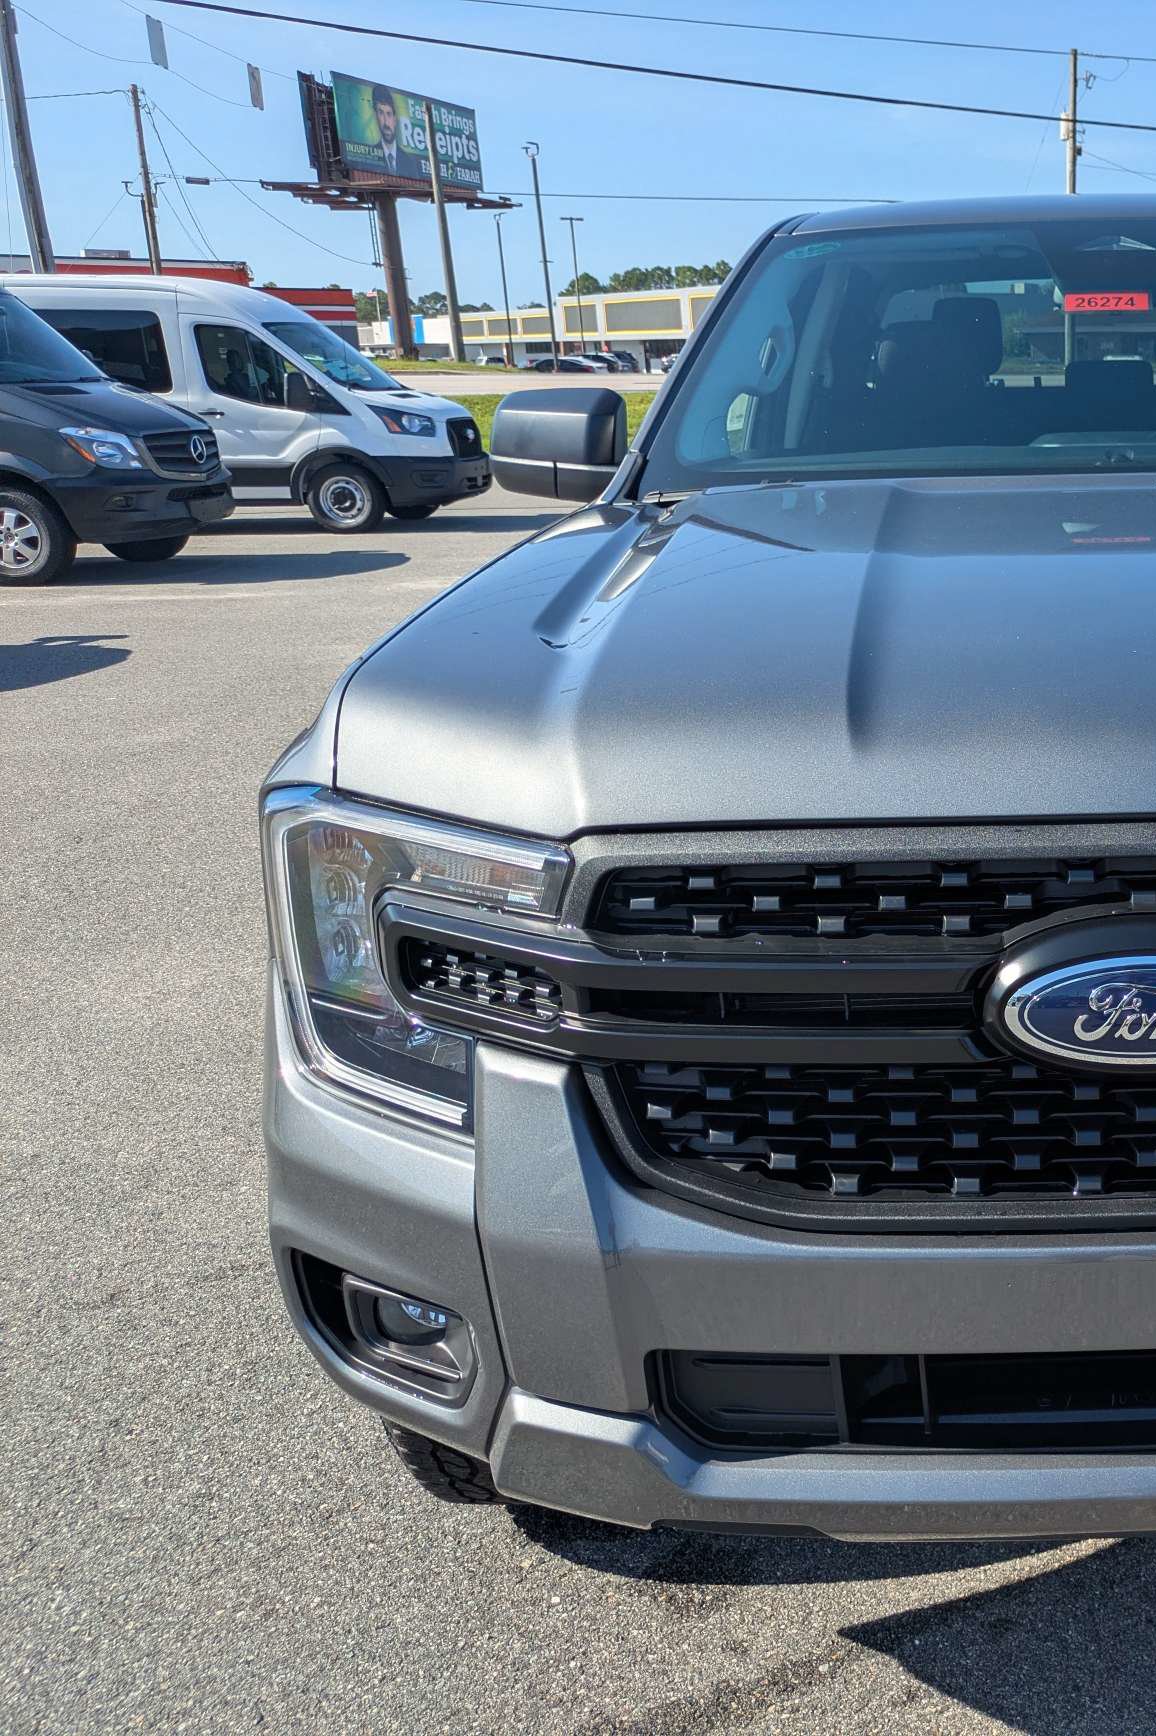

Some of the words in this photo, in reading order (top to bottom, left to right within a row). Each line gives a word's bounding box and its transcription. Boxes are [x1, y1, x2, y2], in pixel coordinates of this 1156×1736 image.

[441, 107, 474, 135] Brings
[345, 142, 369, 155] INJURY
[400, 118, 479, 163] Reeipts
[420, 160, 447, 177] FAH
[456, 167, 480, 184] FARAH
[1075, 296, 1136, 309] 26274
